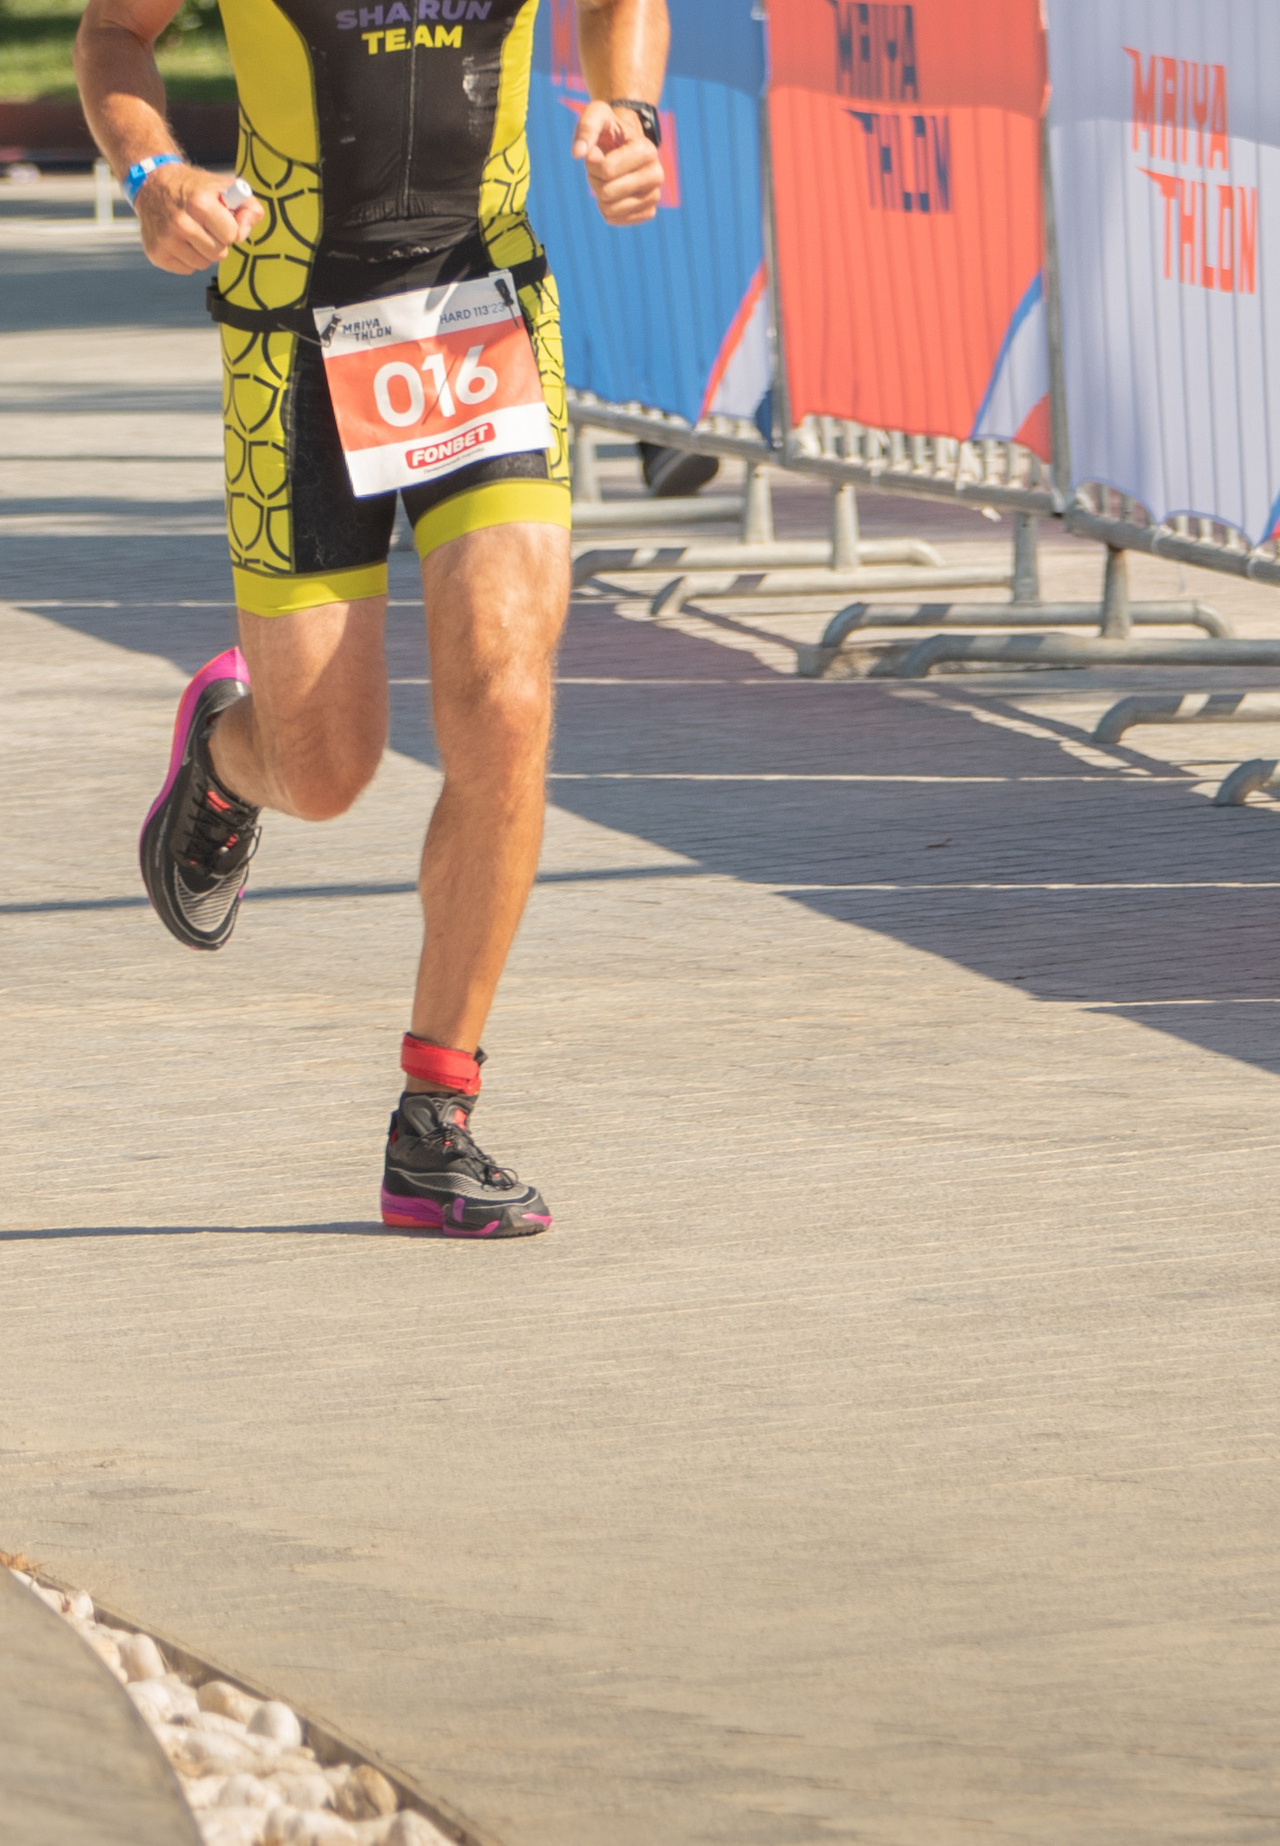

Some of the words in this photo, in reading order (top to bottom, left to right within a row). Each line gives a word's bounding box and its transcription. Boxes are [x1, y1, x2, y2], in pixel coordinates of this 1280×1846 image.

[361, 25, 463, 55] TEAM
[1121, 45, 1229, 172] MRIYA
[841, 109, 952, 216] THLON
[1134, 165, 1257, 295] THLON
[342, 317, 381, 335] MRIYA
[354, 325, 392, 342] THLON
[439, 309, 471, 325] HARD
[373, 344, 498, 428] 016
[411, 425, 489, 467] FONBET
